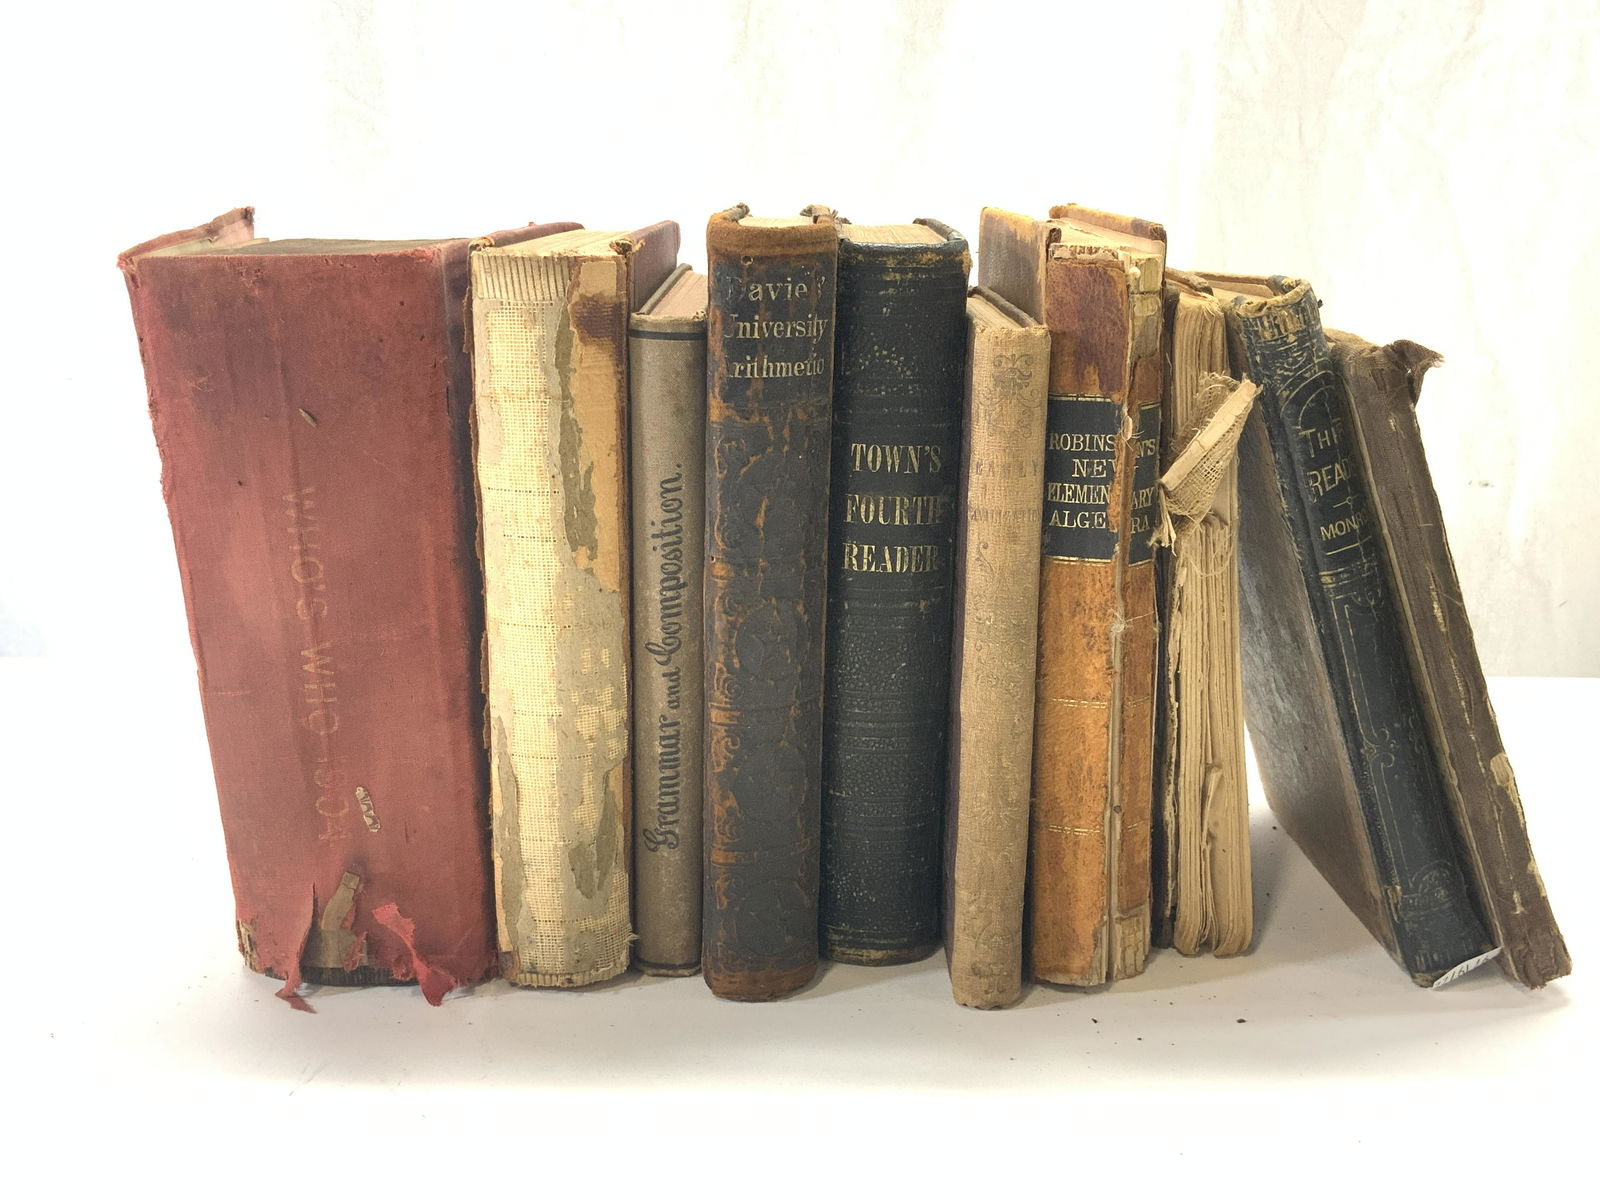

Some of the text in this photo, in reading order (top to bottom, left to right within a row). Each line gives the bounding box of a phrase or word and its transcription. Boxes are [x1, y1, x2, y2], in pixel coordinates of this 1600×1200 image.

[725, 352, 825, 379] rithmetic
[851, 443, 942, 473] TOWN'S
[1049, 432, 1156, 459] ROBINSN'S
[1306, 457, 1353, 498] READ
[843, 494, 945, 526] FOURTH
[1048, 482, 1155, 510] ELEMENARY
[1048, 510, 1150, 534] ALGERA
[282, 486, 328, 620] WHO'S
[841, 542, 940, 573] READER
[643, 463, 688, 852] Grammar and Composition.
[301, 641, 340, 734] WHO
